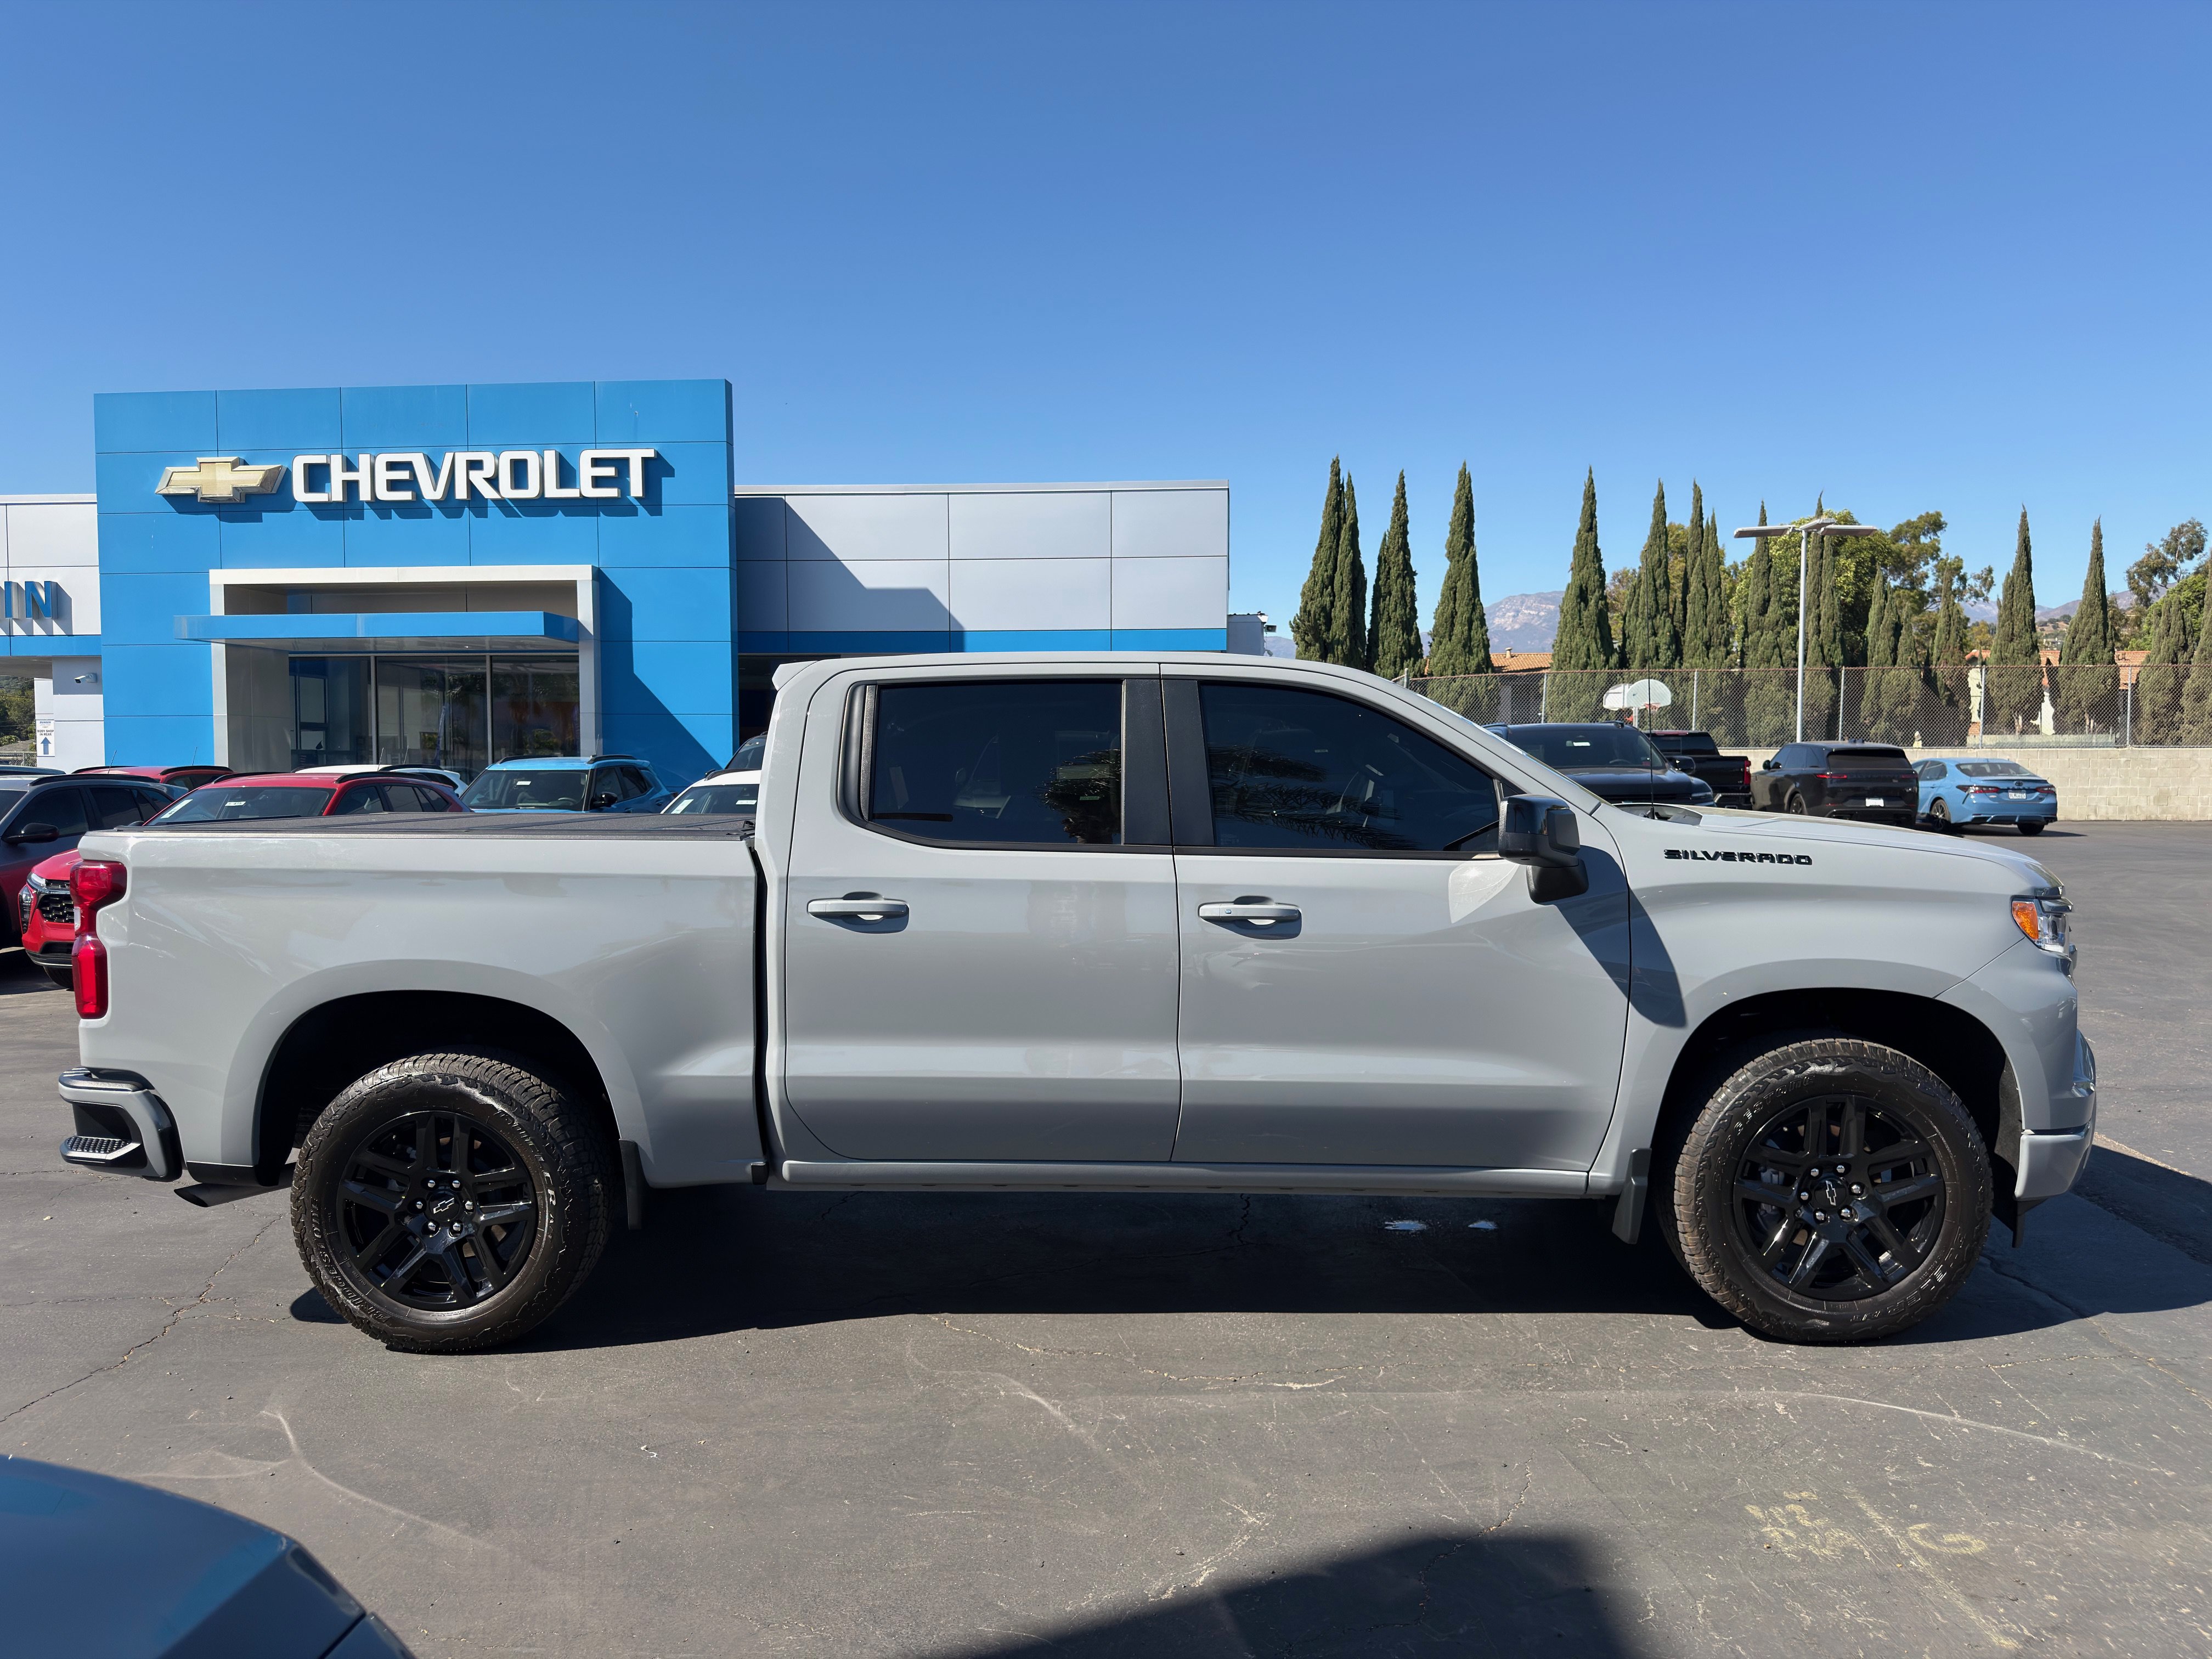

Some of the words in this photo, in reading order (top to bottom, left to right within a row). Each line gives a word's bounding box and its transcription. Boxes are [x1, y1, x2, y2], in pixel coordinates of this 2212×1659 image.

[292, 448, 655, 503] CHEVROLET
[1663, 849, 1813, 866] SILVERADO
[311, 1196, 390, 1323] BRIDGESTONE
